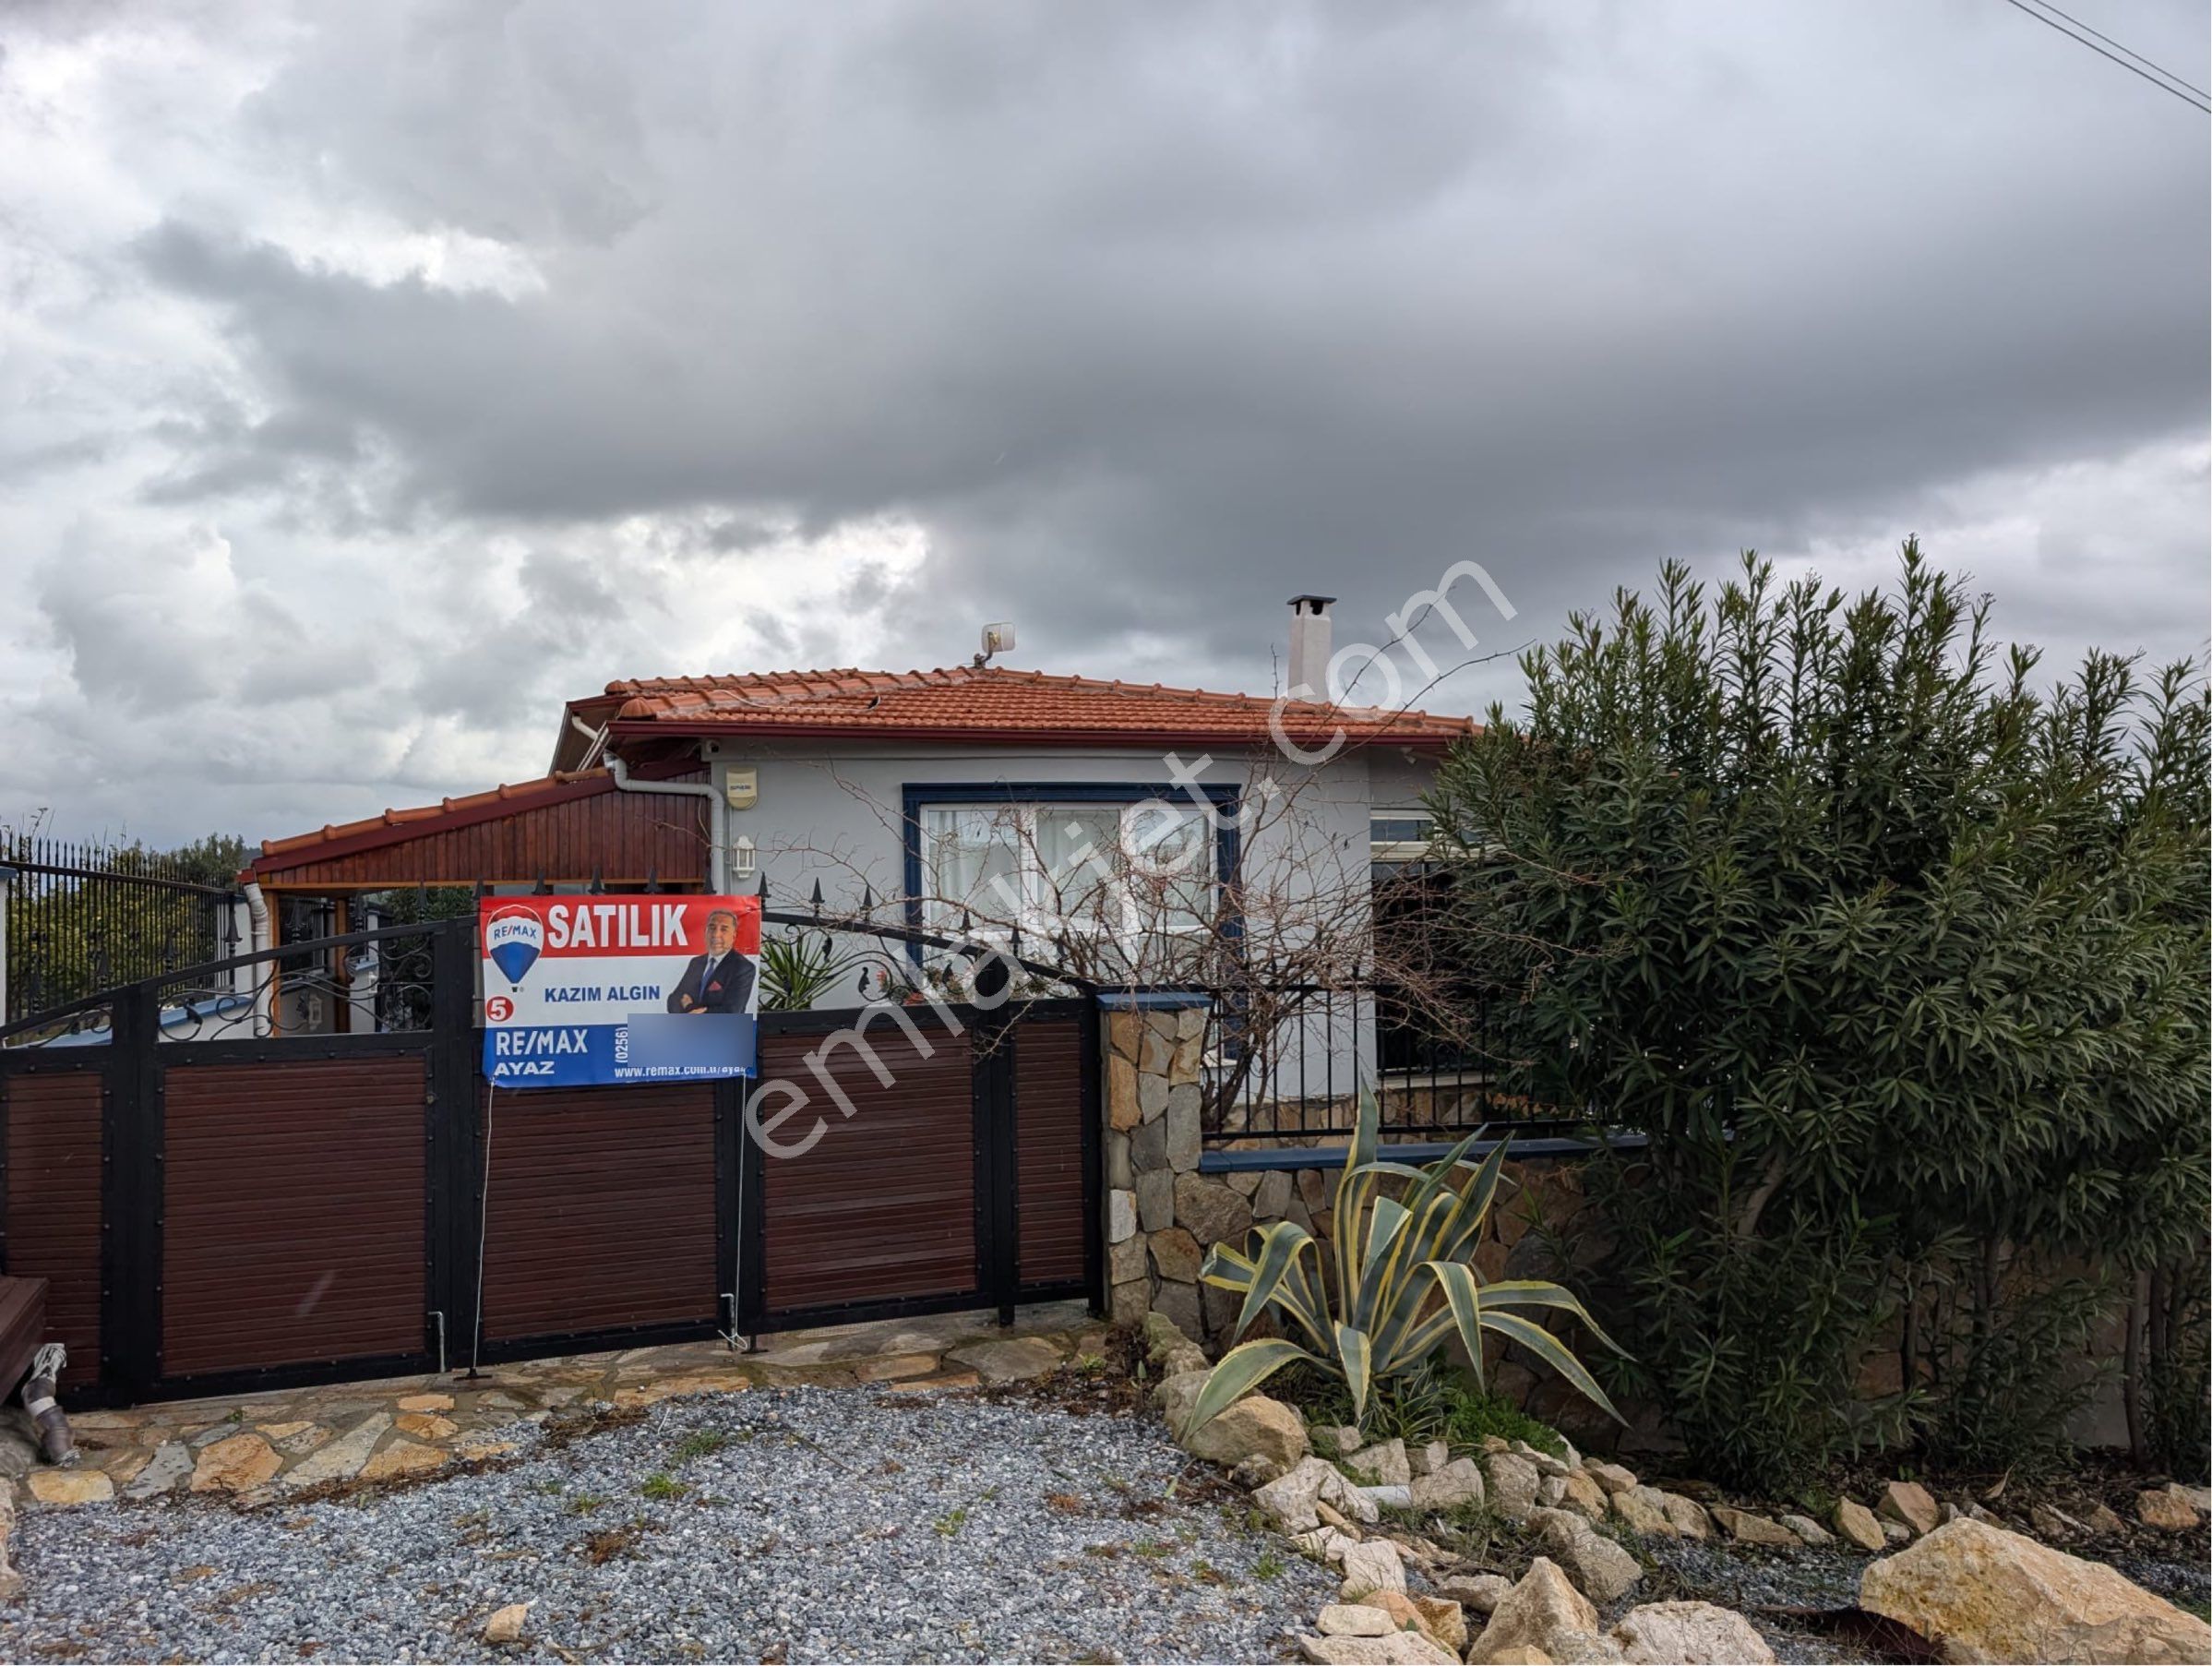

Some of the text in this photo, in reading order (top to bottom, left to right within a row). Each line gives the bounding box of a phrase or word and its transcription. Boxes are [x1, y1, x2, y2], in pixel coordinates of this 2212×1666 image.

[494, 925, 537, 941] RE/MAX
[548, 904, 688, 949] SATILIK
[544, 986, 660, 1002] KAZIM ALGIN
[490, 999, 507, 1021] 5
[496, 1029, 588, 1056] RE/MAX
[494, 1061, 555, 1075] AYAZ
